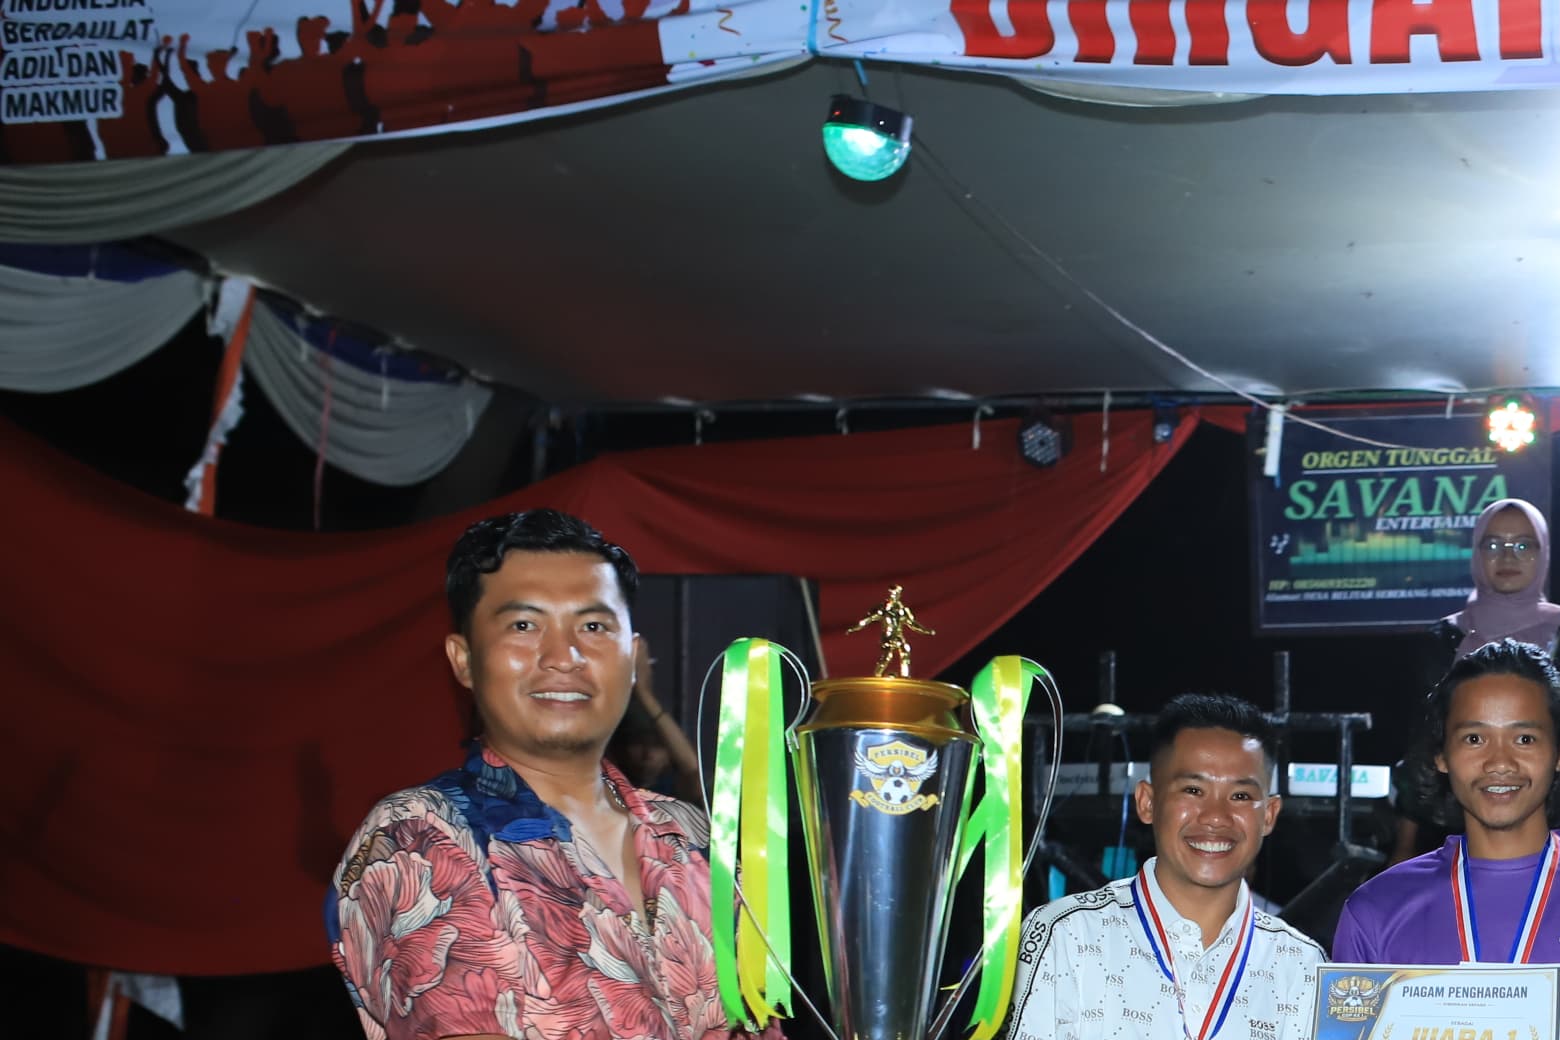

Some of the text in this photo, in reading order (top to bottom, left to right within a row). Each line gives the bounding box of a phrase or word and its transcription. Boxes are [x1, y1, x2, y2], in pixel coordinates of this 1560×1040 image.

[3, 19, 154, 44] BERDAULAT
[4, 50, 118, 80] ADIL DAN
[5, 88, 118, 118] MAKMUR
[1302, 447, 1497, 469] ORGEN TUNGGAL
[1284, 474, 1511, 520] SAVANA
[1294, 767, 1369, 784] SAVAA
[1074, 886, 1115, 905] BOSS
[1019, 921, 1047, 965] BOSS
[1402, 985, 1528, 999] PIAGAM PENGHARGAAN
[1083, 1008, 1104, 1018] OSS
[1122, 1008, 1153, 1022] BOSS
[1330, 1006, 1375, 1016] PERSIBEL
[1250, 1019, 1276, 1032] BOSS
